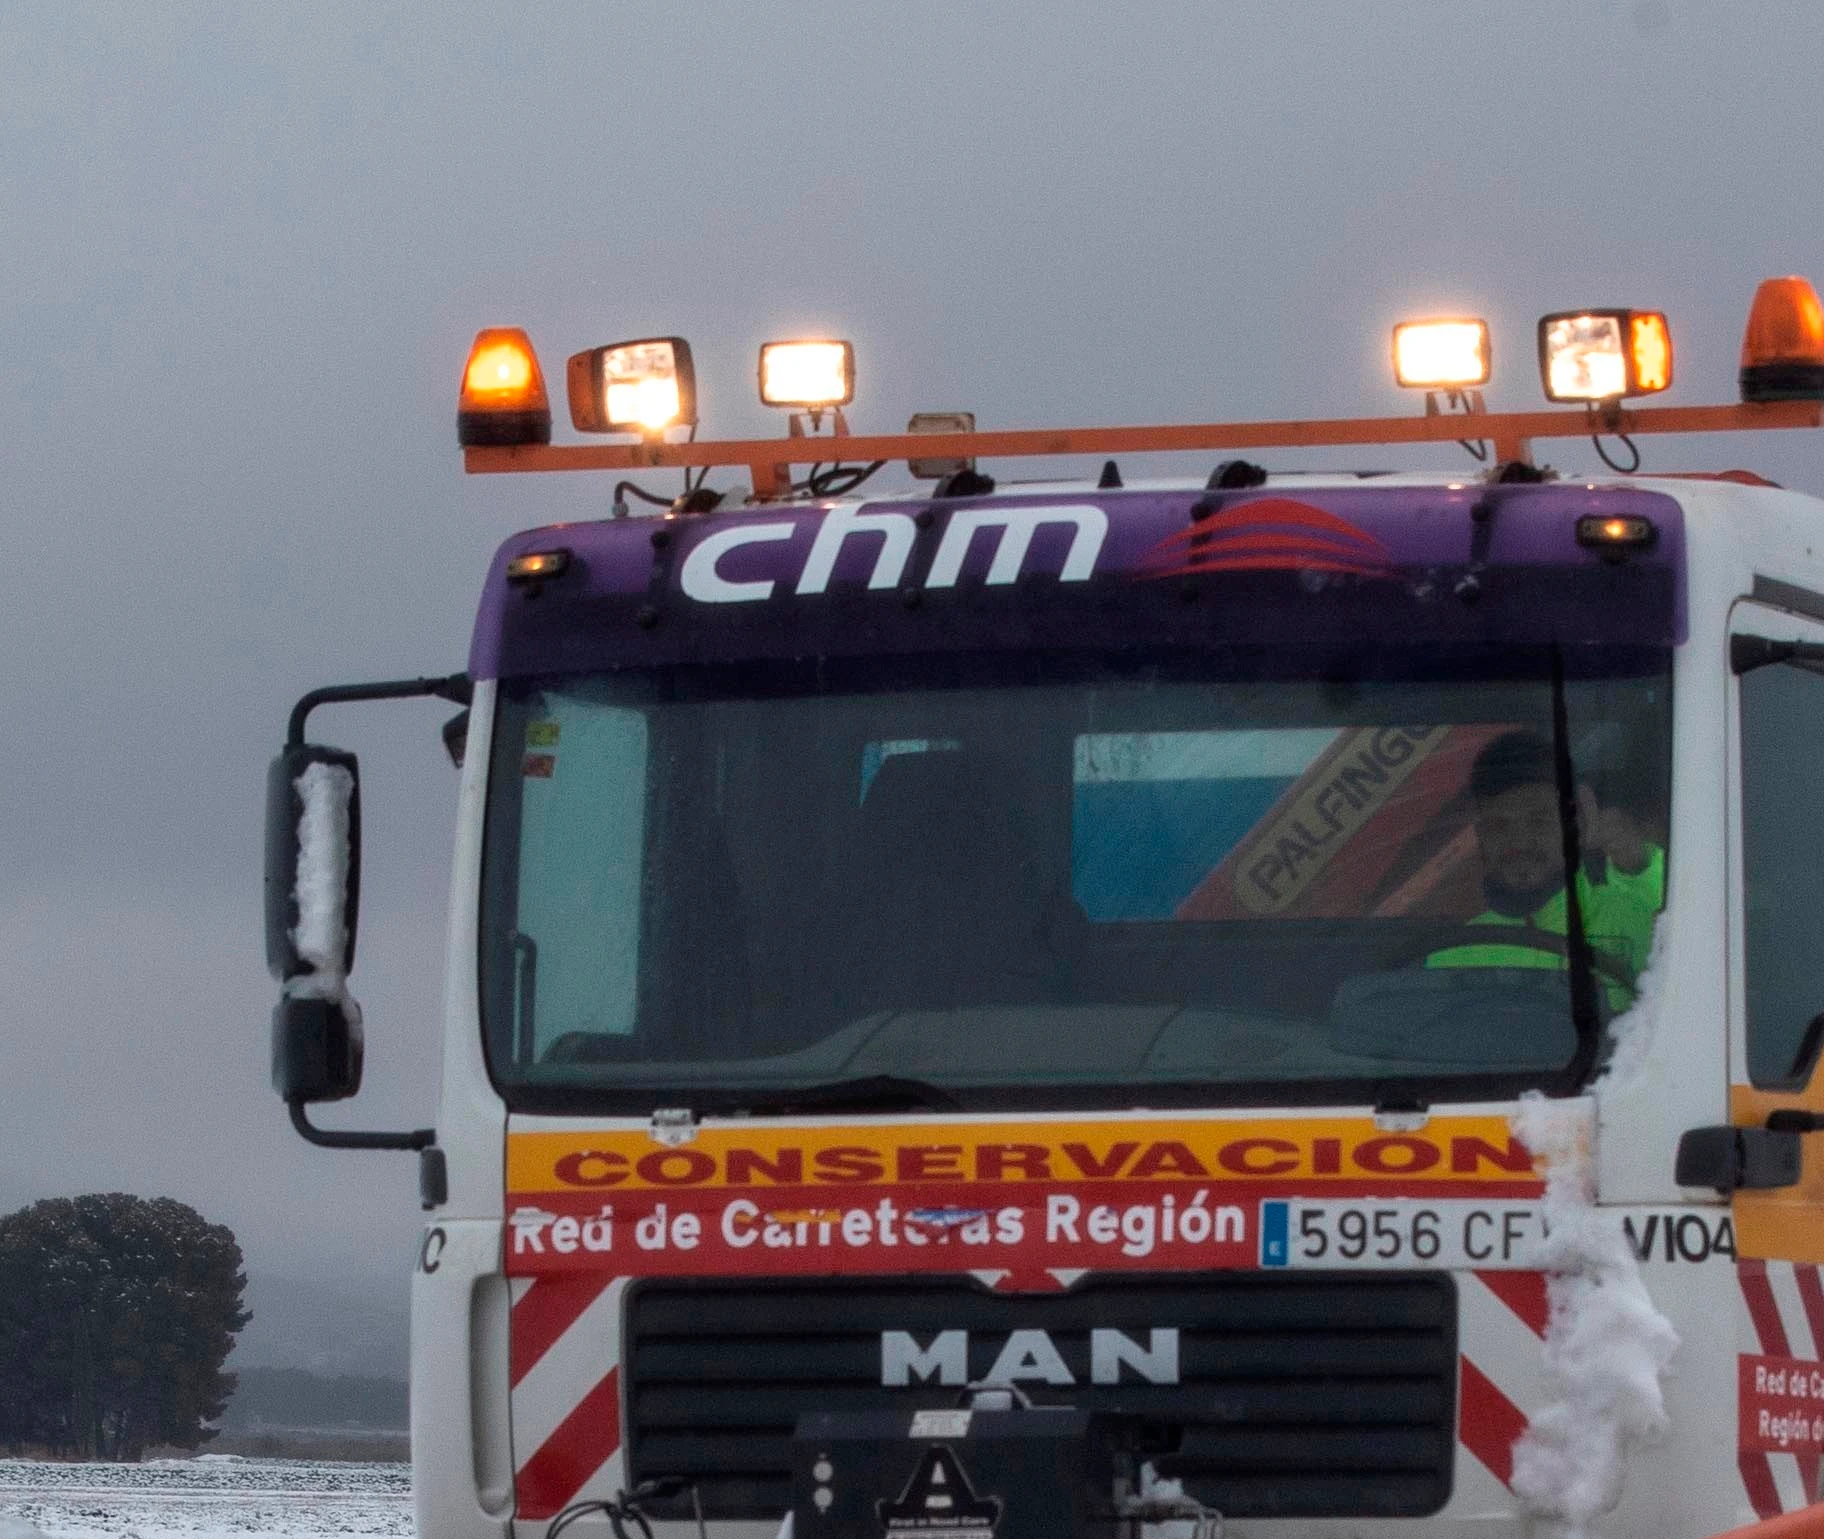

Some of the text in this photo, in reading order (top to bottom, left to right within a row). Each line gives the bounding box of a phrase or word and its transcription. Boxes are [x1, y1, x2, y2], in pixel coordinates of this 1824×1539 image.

[680, 501, 1110, 603] chm
[512, 1188, 1246, 1257] Red de Carretas Región
[1299, 1209, 1550, 1261] 5956 CF
[881, 1327, 1181, 1387] MAN
[1755, 1364, 1787, 1396] Red
[1790, 1370, 1807, 1398] de
[1758, 1408, 1810, 1447] Región
